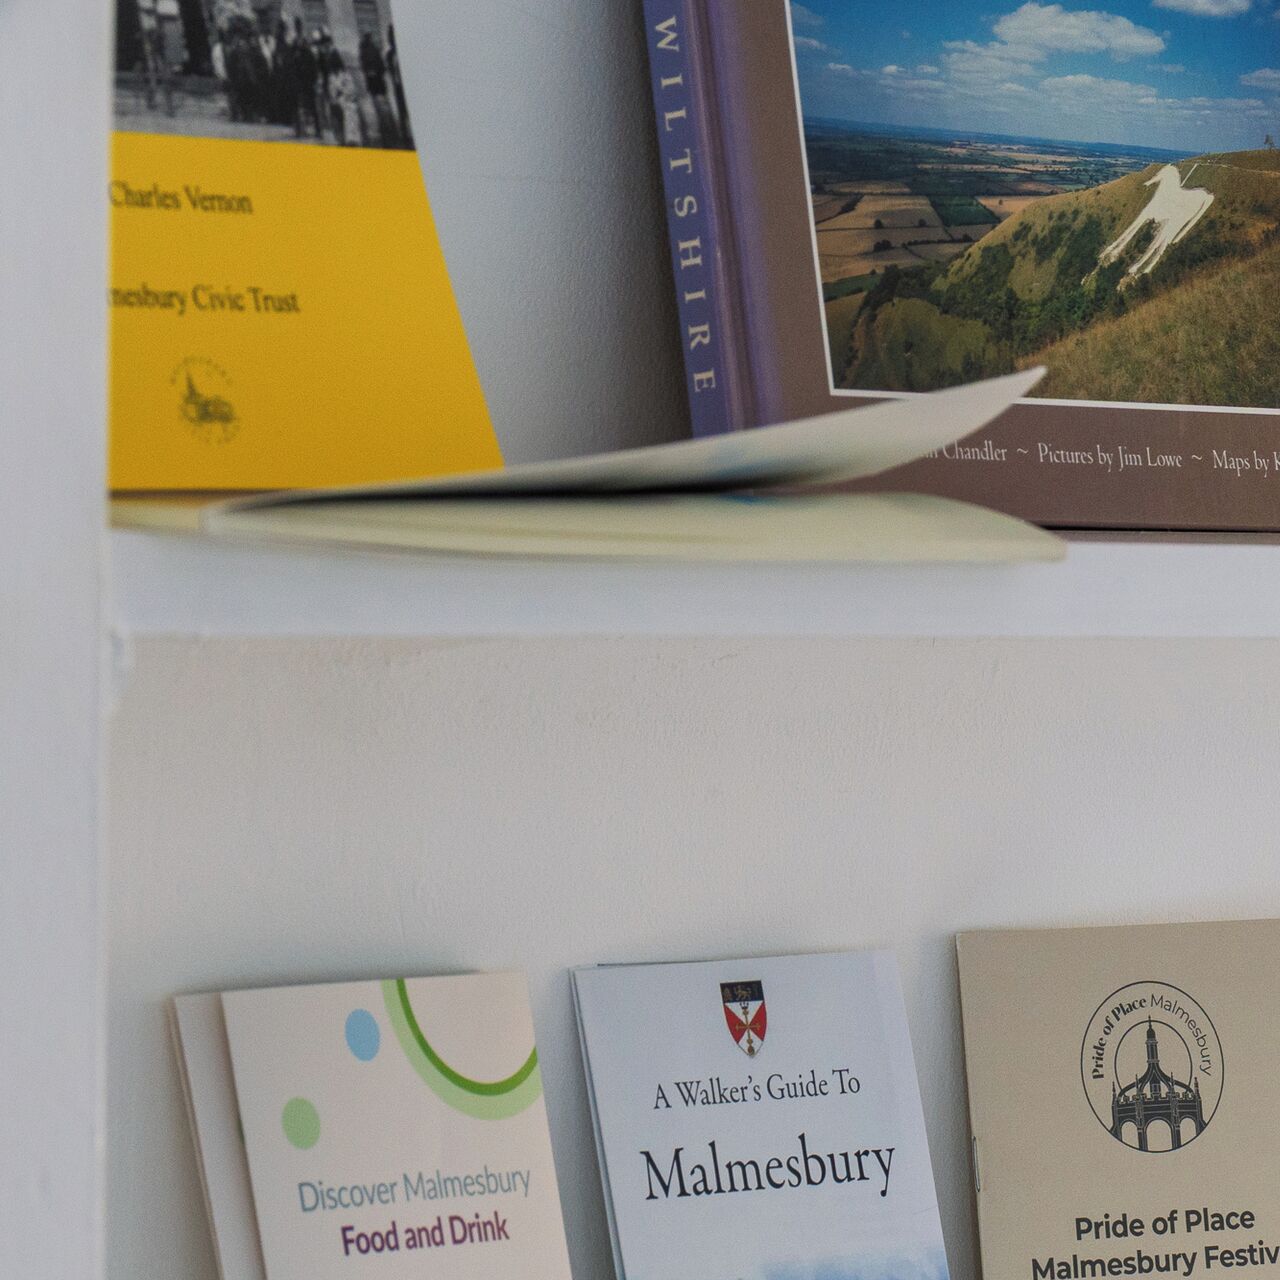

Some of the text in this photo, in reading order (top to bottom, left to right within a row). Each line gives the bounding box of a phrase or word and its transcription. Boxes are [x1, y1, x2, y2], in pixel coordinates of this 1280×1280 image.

[109, 179, 254, 215] Charles Vernon
[655, 16, 716, 392] WILTSHIRE
[191, 283, 300, 313] Civic Trust
[943, 440, 1007, 462] Chandler
[1038, 443, 1094, 465] Pictures
[1097, 444, 1114, 472] by
[1117, 446, 1143, 472] Jim
[1146, 447, 1183, 468] Lowe
[1212, 449, 1251, 477] Maps
[1253, 450, 1270, 478] by
[1092, 994, 1211, 1079] Pride of Place Malmesbury
[654, 1068, 861, 1109] A Walker's Guide To
[639, 1132, 895, 1200] Malmesbury
[298, 1164, 531, 1212] Discover Malmesbury
[341, 1211, 510, 1256] Food and Drink
[1075, 1207, 1256, 1241] Pride of Place
